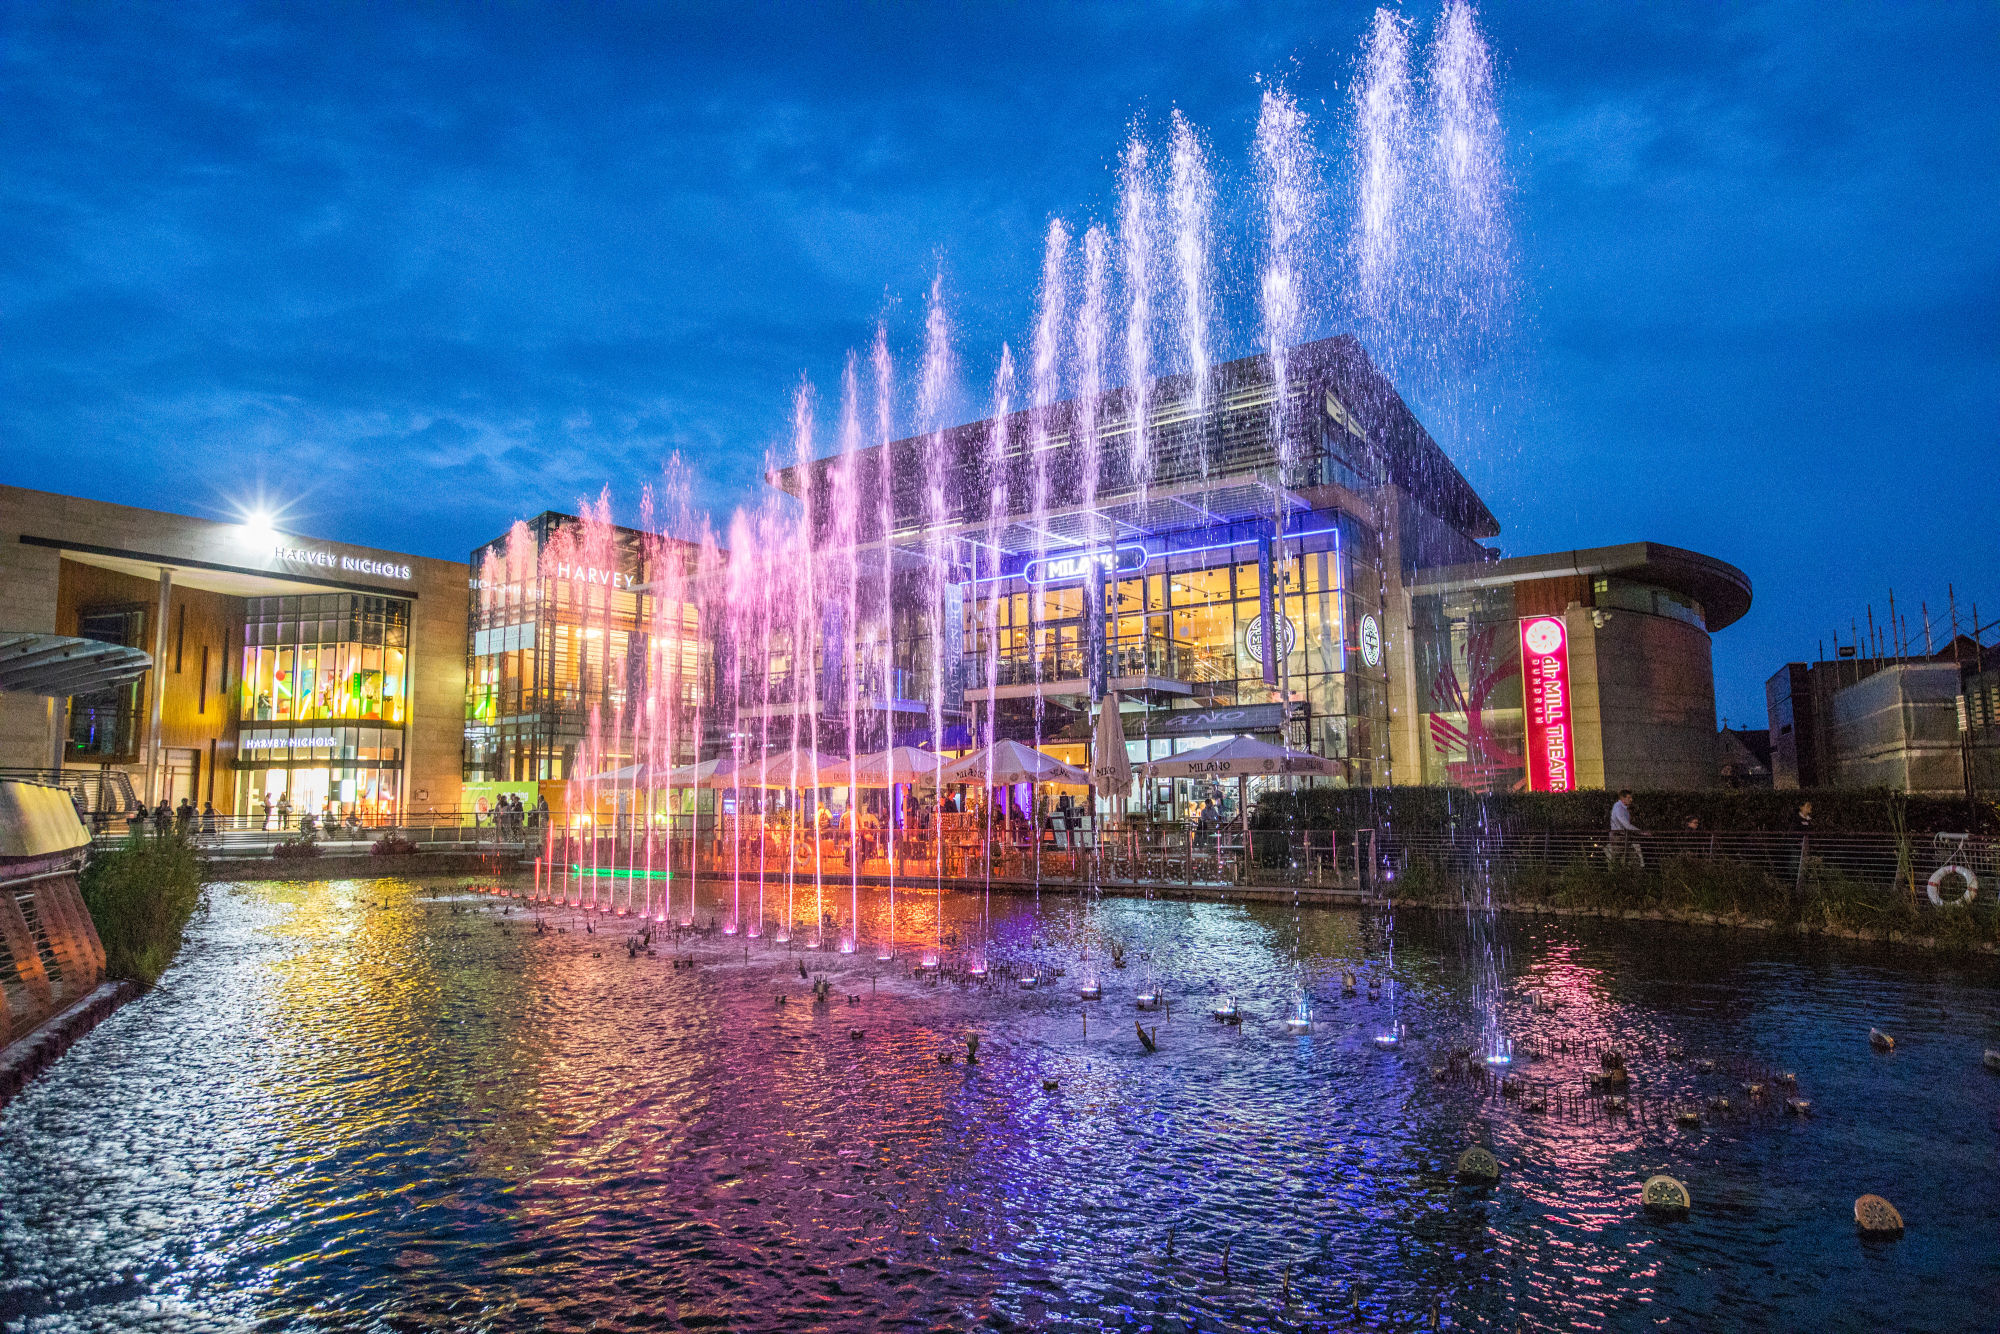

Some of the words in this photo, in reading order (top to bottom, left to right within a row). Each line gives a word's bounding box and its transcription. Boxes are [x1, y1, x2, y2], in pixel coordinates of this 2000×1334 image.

[274, 546, 337, 567] HARVEY
[341, 556, 412, 579] NICHOLS
[557, 561, 635, 588] HARVEY
[1542, 656, 1559, 678] dlr
[1532, 658, 1544, 725] DUNDRUM
[1544, 679, 1563, 724] MILL
[288, 736, 336, 748] NICHOLS
[1188, 761, 1231, 773] MILANO
